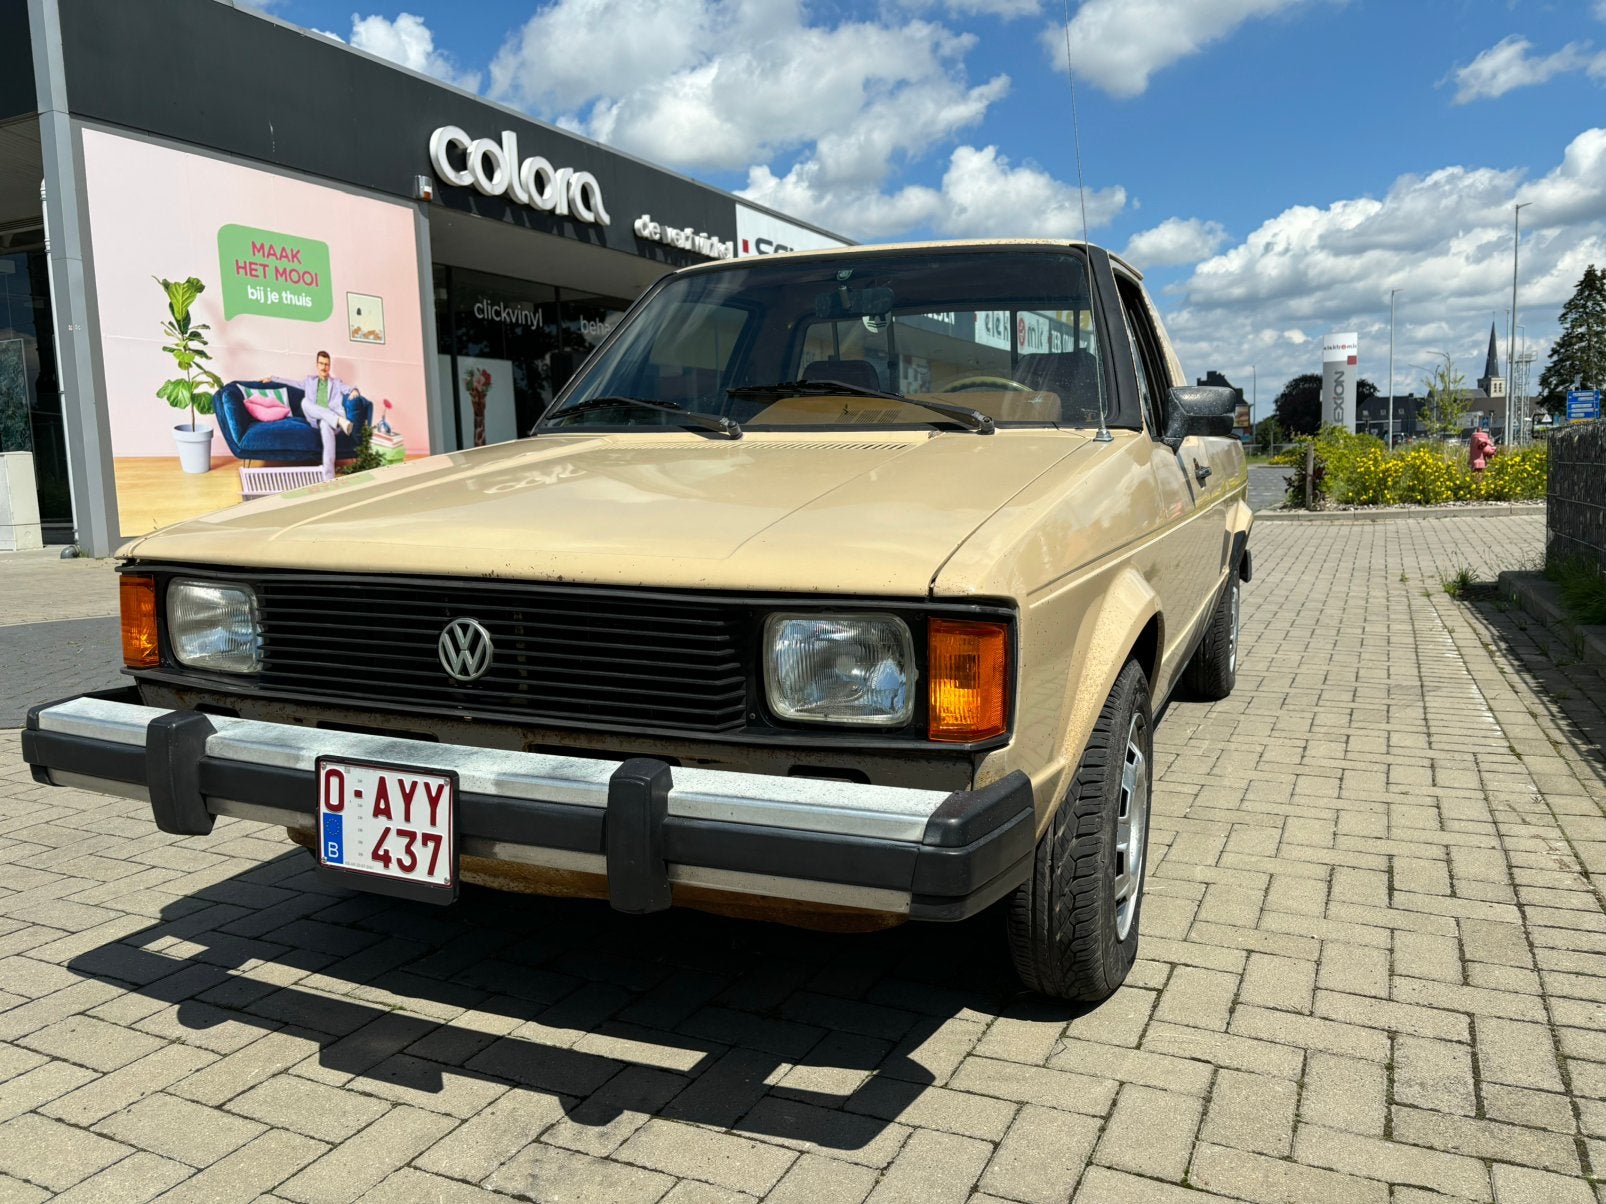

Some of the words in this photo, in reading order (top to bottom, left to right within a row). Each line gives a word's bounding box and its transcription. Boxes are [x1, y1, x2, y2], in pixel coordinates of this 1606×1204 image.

[430, 125, 611, 226] colora
[634, 214, 661, 238] de
[251, 240, 302, 265] MAAK
[235, 259, 269, 280] HET
[274, 266, 319, 288] MOOI
[247, 285, 264, 304] bij
[267, 288, 279, 305] je
[281, 291, 313, 308] thuis
[474, 299, 543, 330] clickvinyl
[439, 618, 491, 680] VW
[328, 842, 339, 858] B
[371, 827, 443, 877] 437
